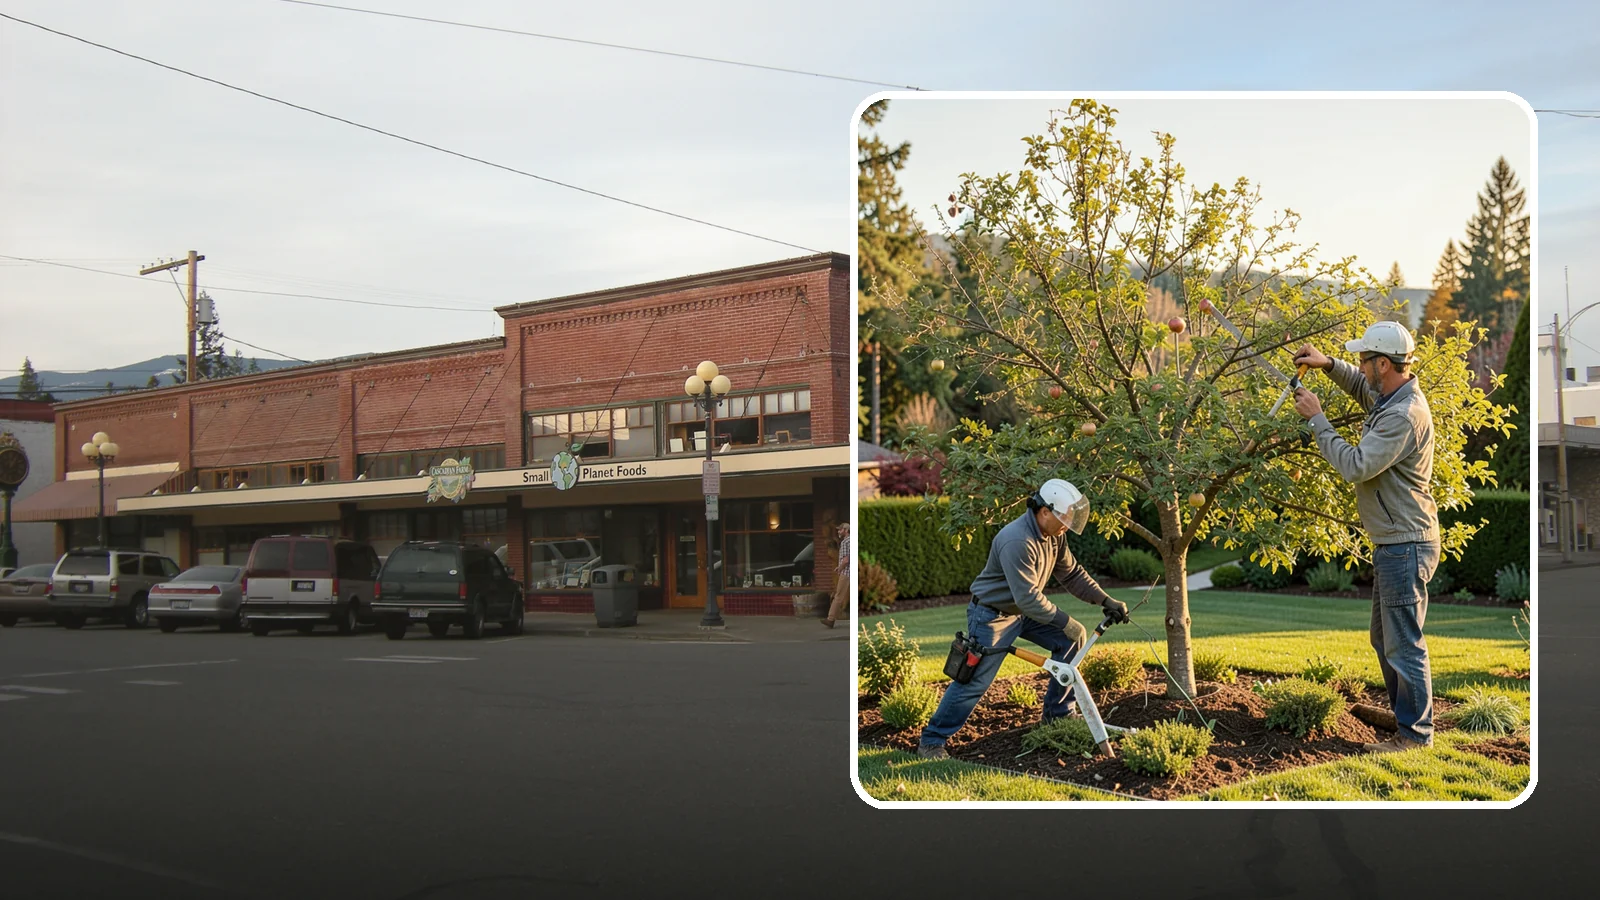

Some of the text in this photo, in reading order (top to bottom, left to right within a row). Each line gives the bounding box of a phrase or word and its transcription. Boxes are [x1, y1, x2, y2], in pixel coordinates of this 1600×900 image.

[523, 464, 647, 483] Small Planet Foods
